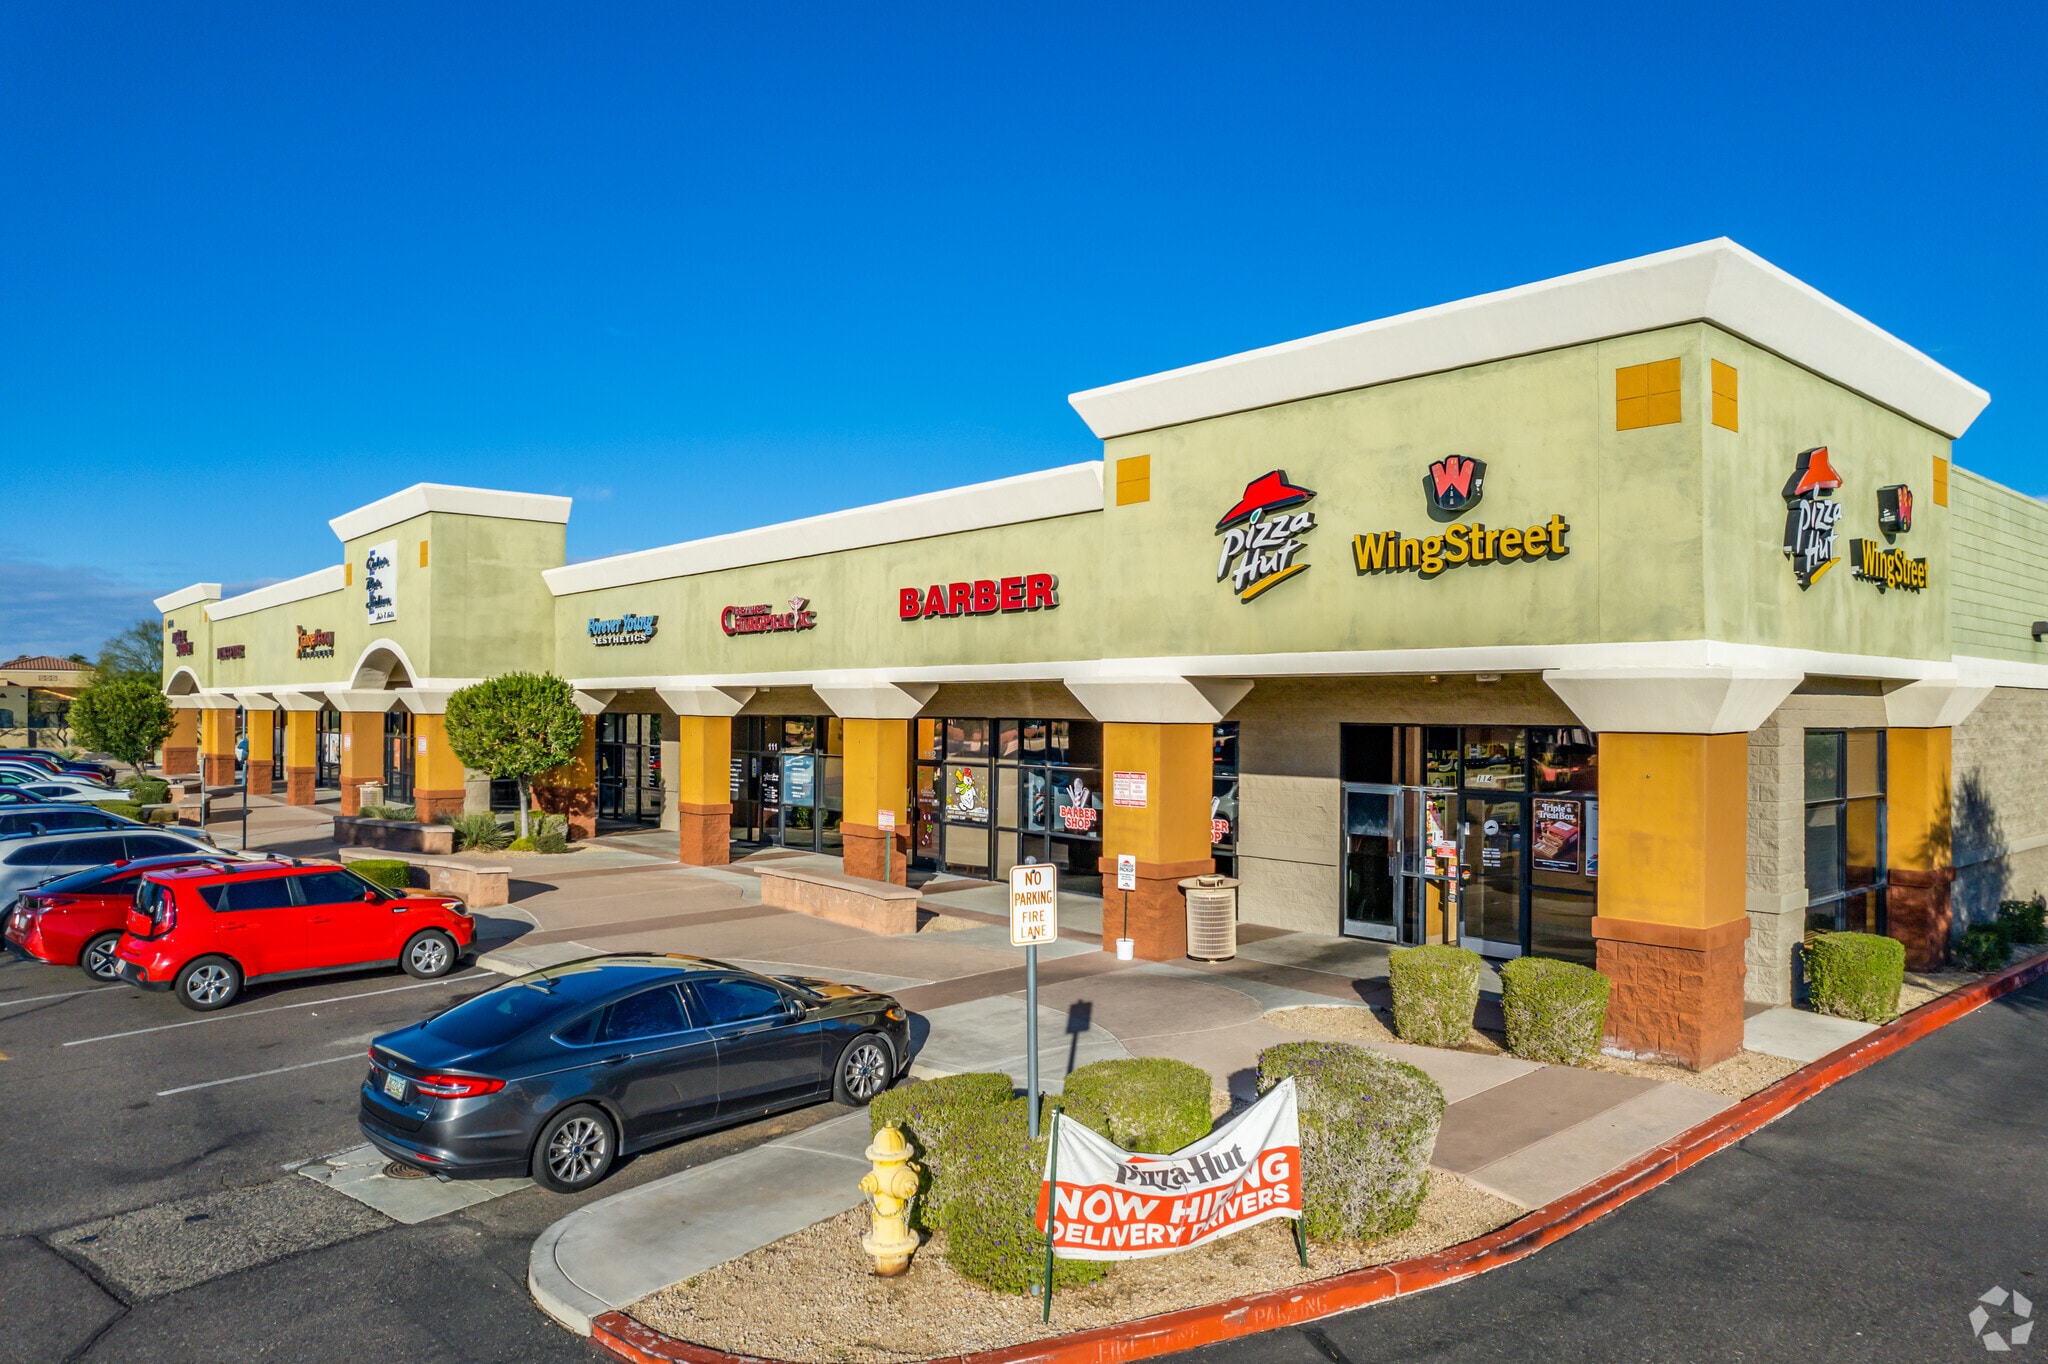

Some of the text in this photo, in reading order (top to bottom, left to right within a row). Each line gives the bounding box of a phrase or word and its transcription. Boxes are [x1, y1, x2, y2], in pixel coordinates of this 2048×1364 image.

[1797, 488, 1842, 553] Pizza
[1217, 508, 1313, 578] Pizza
[1354, 514, 1566, 573] WingStreet
[1805, 529, 1840, 572] Hut
[1234, 540, 1303, 591] Hut
[1862, 538, 1929, 588] WingStreet
[900, 573, 1054, 618] BARBER
[587, 614, 654, 636] Forever Young
[592, 634, 647, 646] AESTHETICS
[768, 743, 778, 751] 111
[1477, 775, 1494, 783] 114
[1060, 805, 1097, 821] BARBER
[1538, 810, 1575, 820] Treat Box
[1541, 803, 1566, 813] Triple
[1065, 817, 1091, 830] SHOP
[1025, 871, 1042, 886] NO
[1015, 890, 1052, 906] PARKING
[1022, 910, 1045, 923] FIRE
[1021, 925, 1047, 939] LANE
[1115, 1143, 1247, 1192] Pizza Hut
[1053, 1152, 1289, 1224] NOW HIRNG
[1044, 1218, 1186, 1247] DELIVERY
